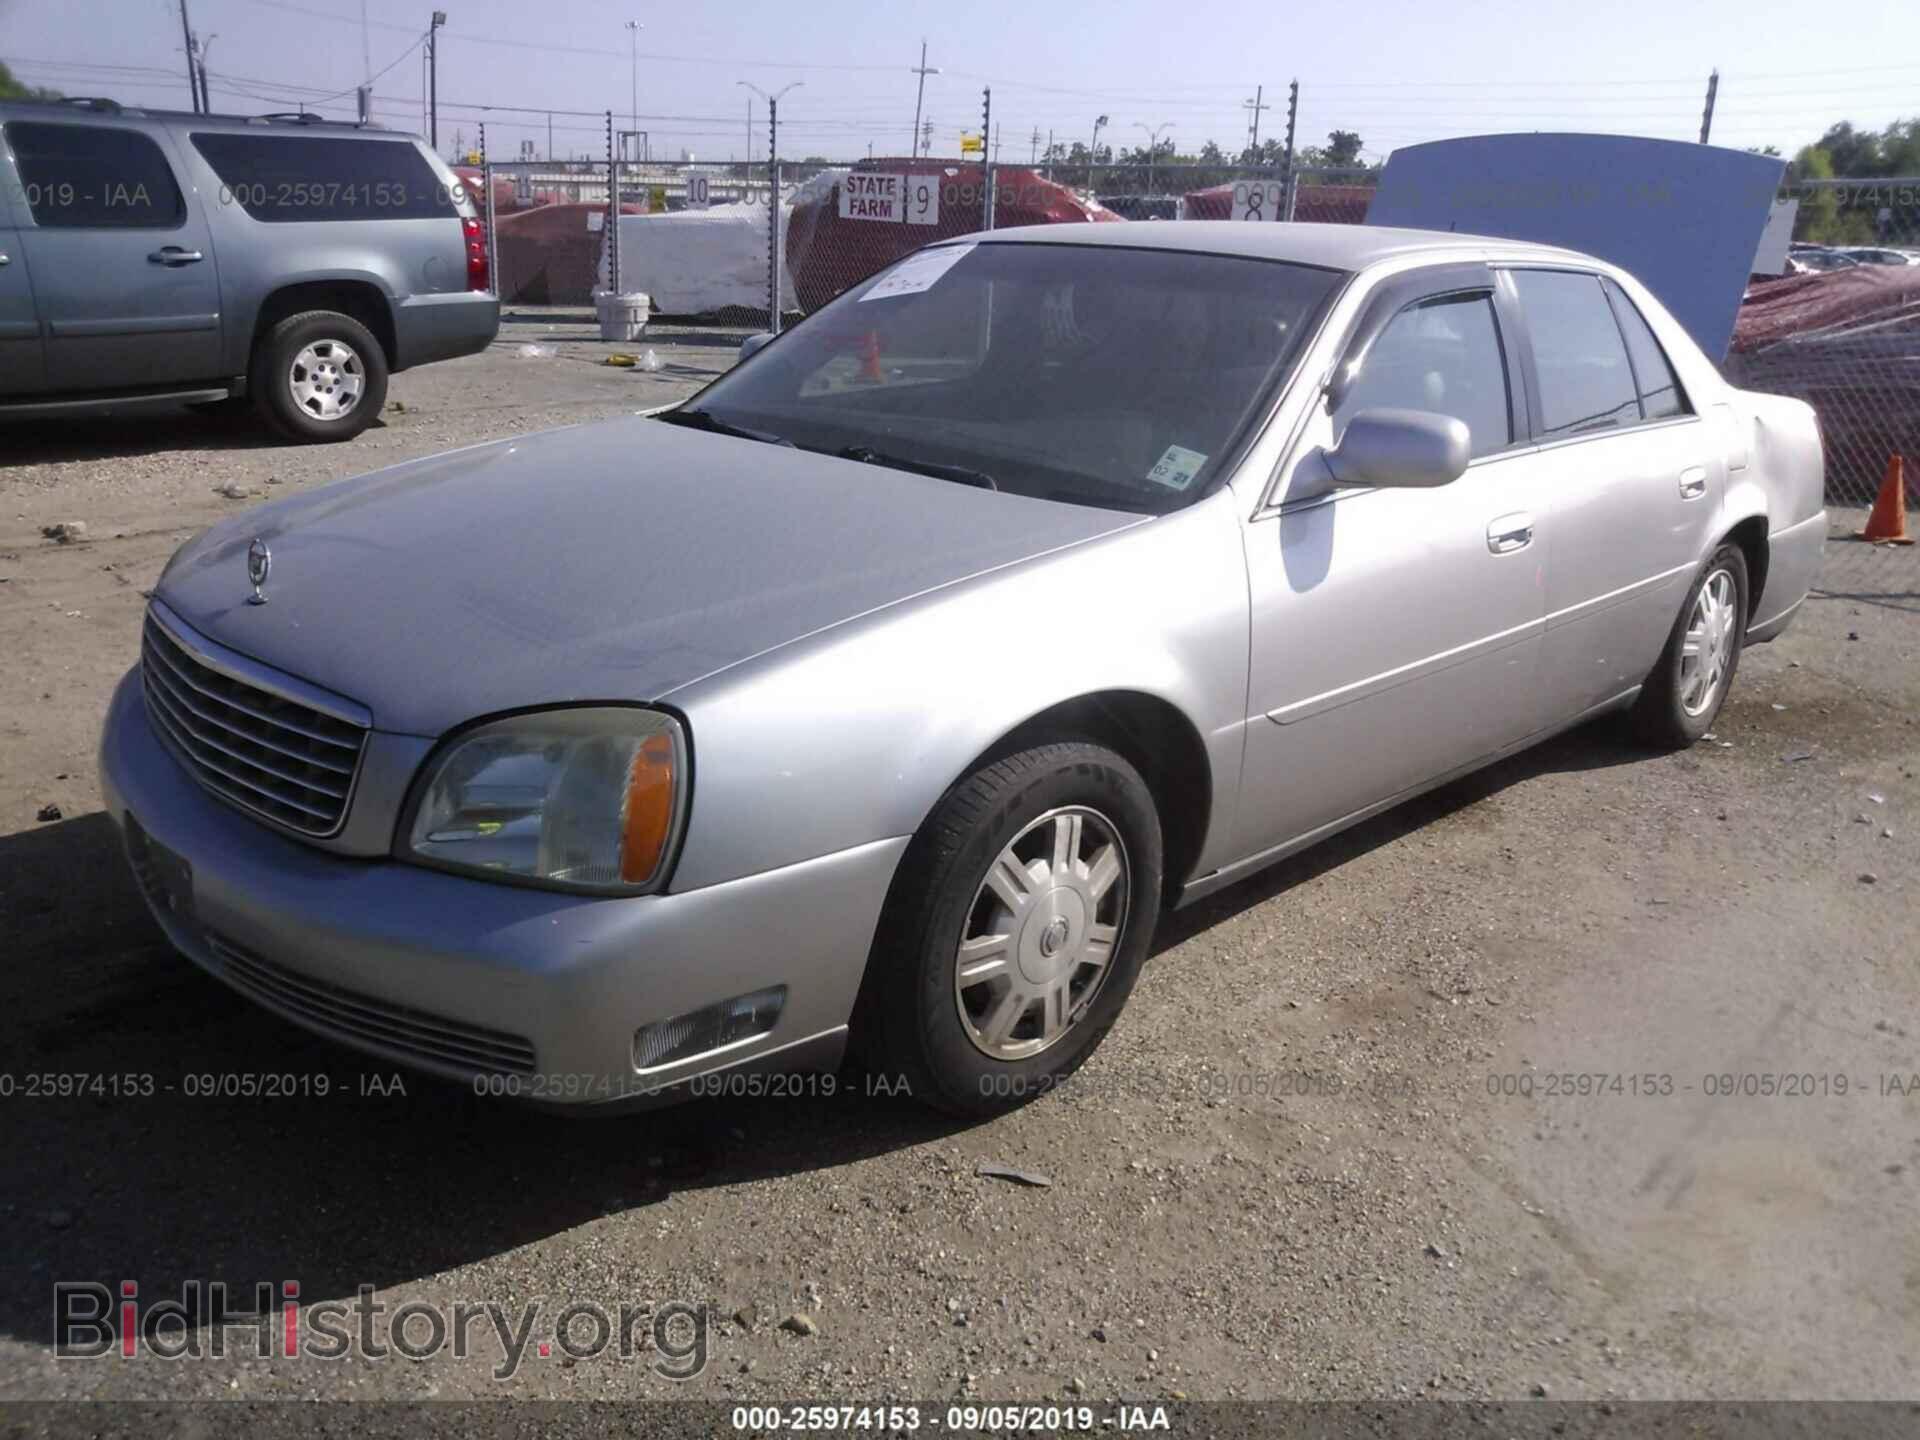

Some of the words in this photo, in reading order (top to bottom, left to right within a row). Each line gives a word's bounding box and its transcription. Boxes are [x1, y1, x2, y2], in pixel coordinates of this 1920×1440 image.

[687, 178, 708, 203] 10
[847, 176, 896, 194] STATE
[849, 199, 892, 217] FARM
[917, 185, 929, 214] 9
[1244, 193, 1263, 220] 8
